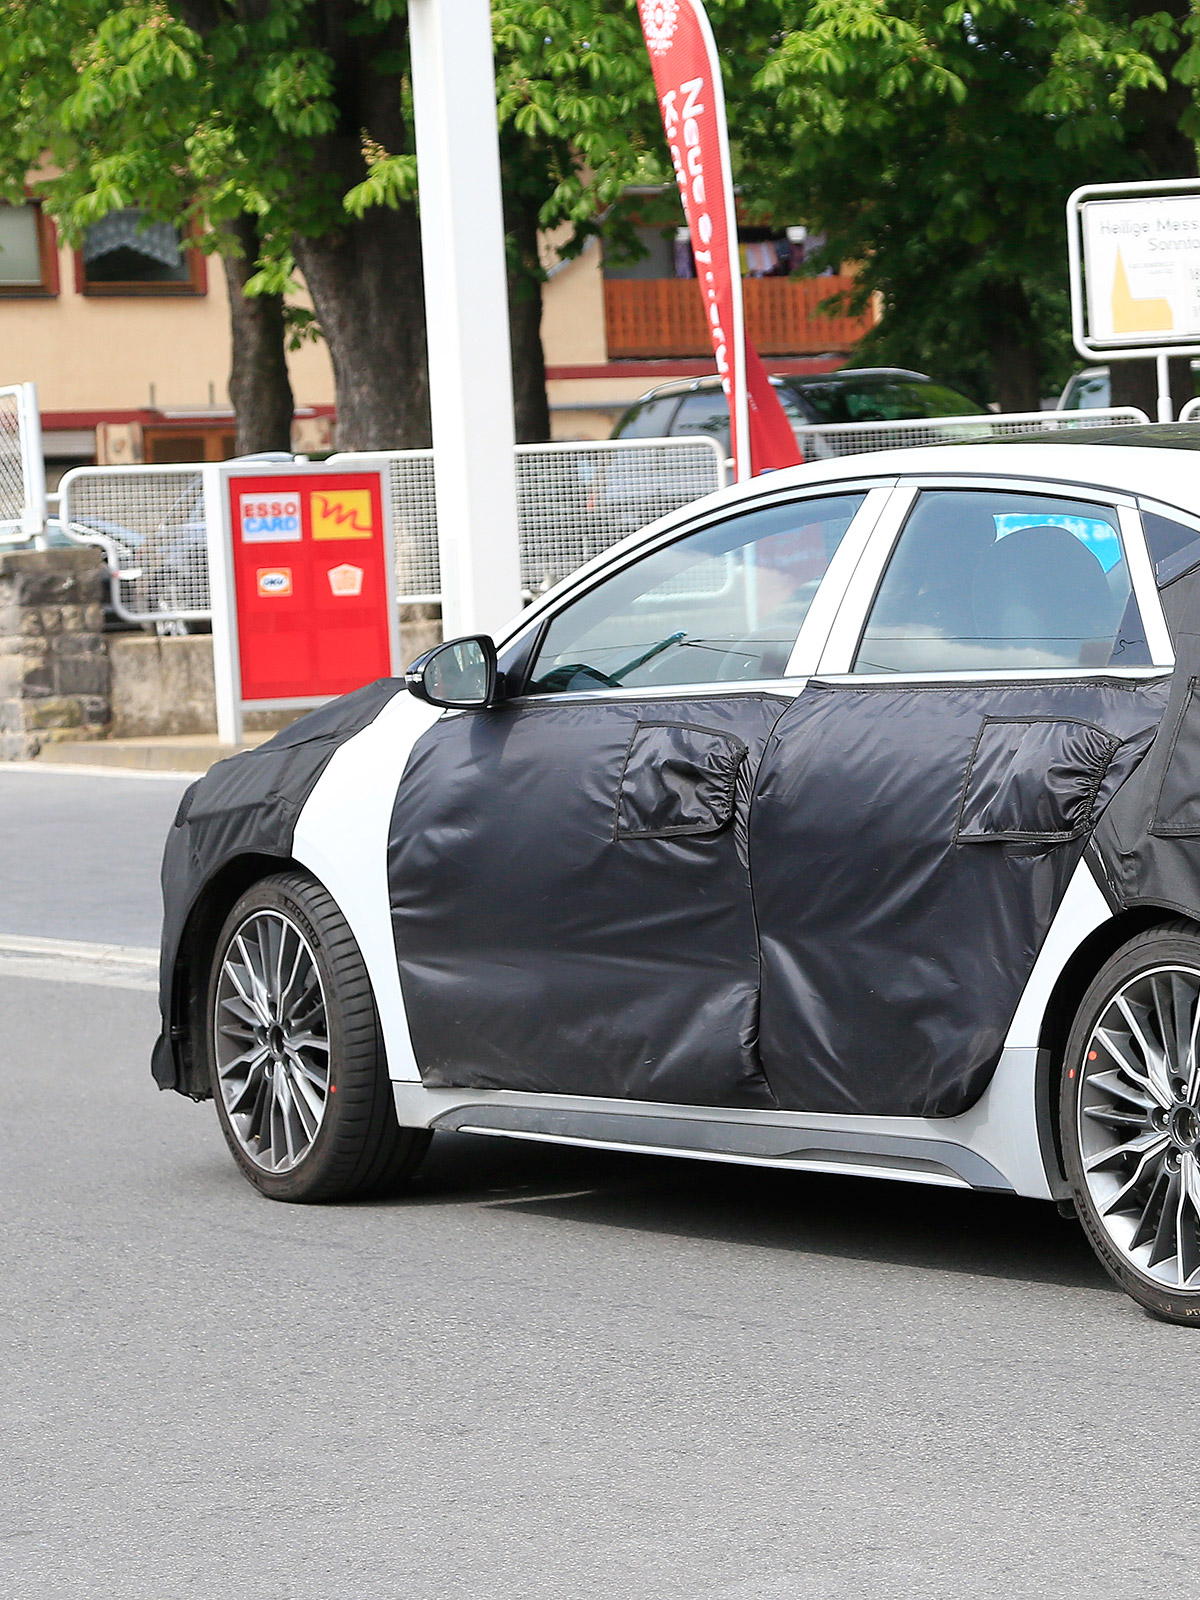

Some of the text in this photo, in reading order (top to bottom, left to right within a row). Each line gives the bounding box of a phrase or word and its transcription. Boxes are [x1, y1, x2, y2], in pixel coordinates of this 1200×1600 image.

[1099, 219, 1150, 237] Heilige
[243, 502, 297, 518] ESSO
[244, 517, 298, 533] CARD
